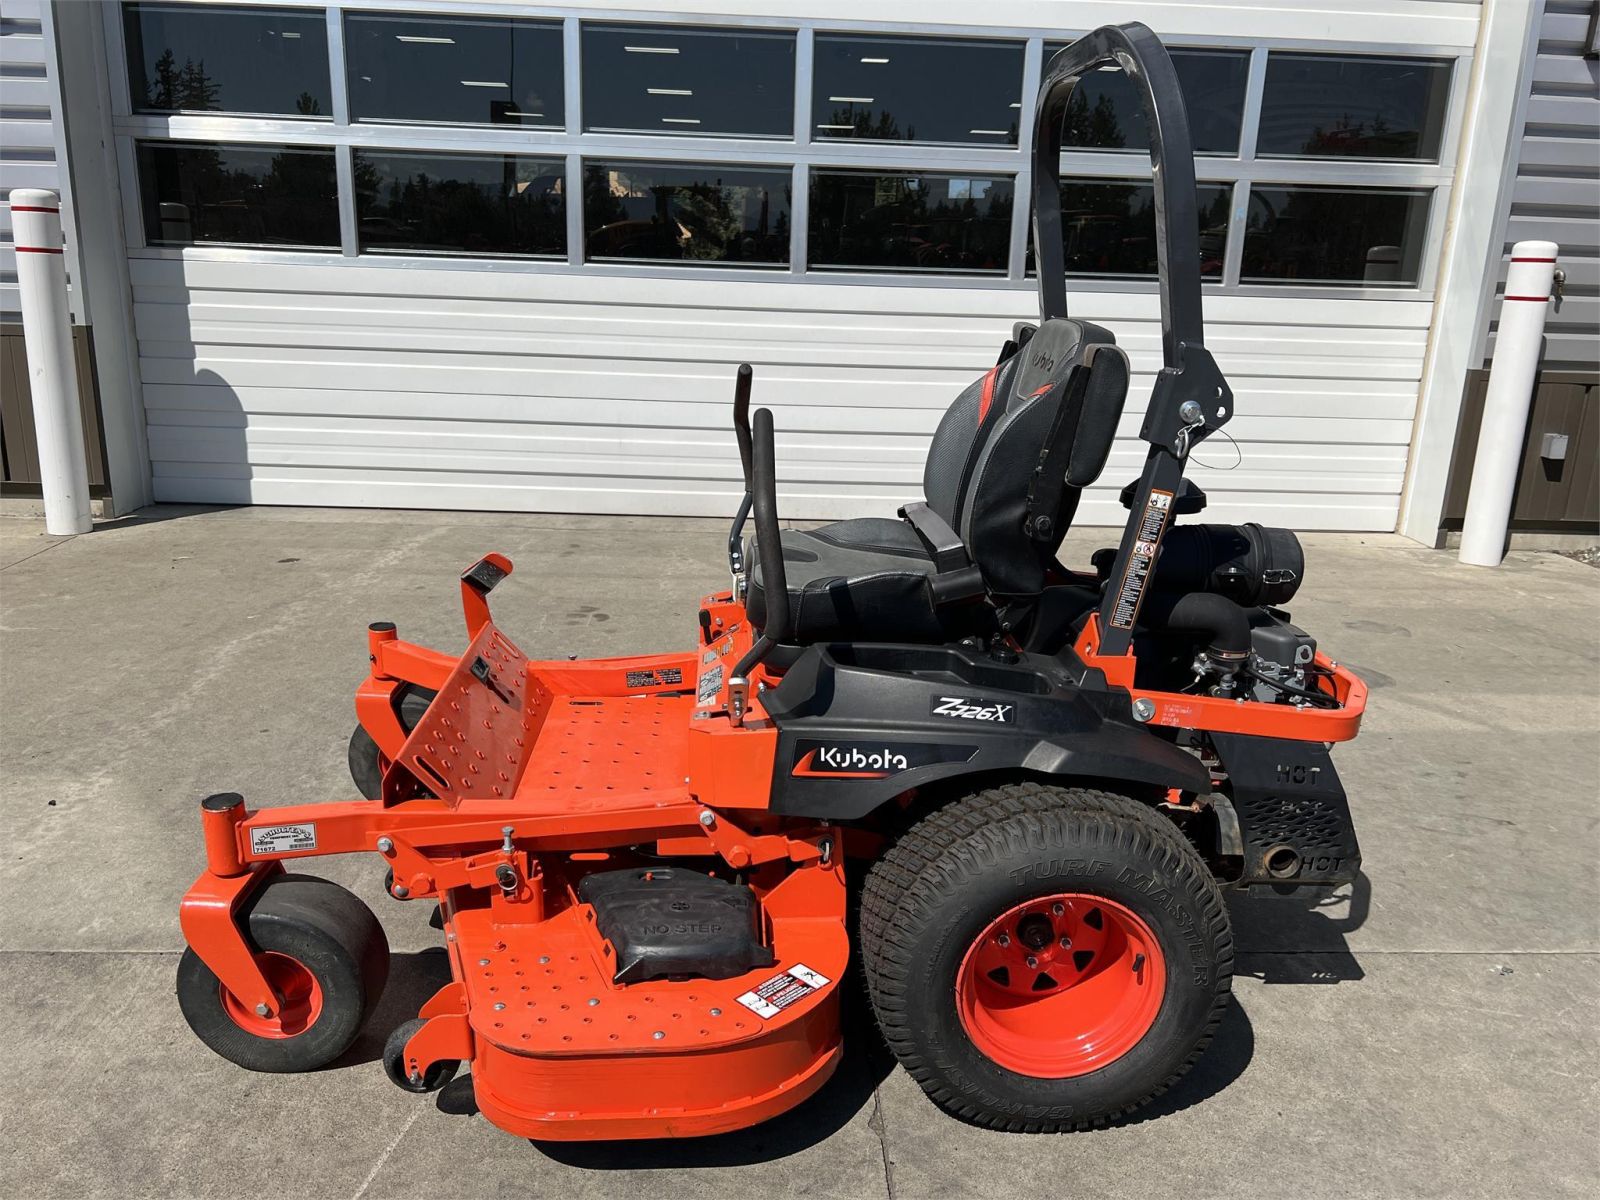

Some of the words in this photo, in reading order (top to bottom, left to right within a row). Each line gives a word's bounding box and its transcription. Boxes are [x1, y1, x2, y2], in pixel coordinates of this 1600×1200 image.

[820, 747, 908, 770] Kubota
[1276, 764, 1321, 785] HOT
[1299, 856, 1345, 872] HOT
[643, 924, 671, 936] NO
[674, 922, 722, 935] STEP
[1008, 857, 1113, 887] TURF
[1115, 865, 1209, 987] MASTER
